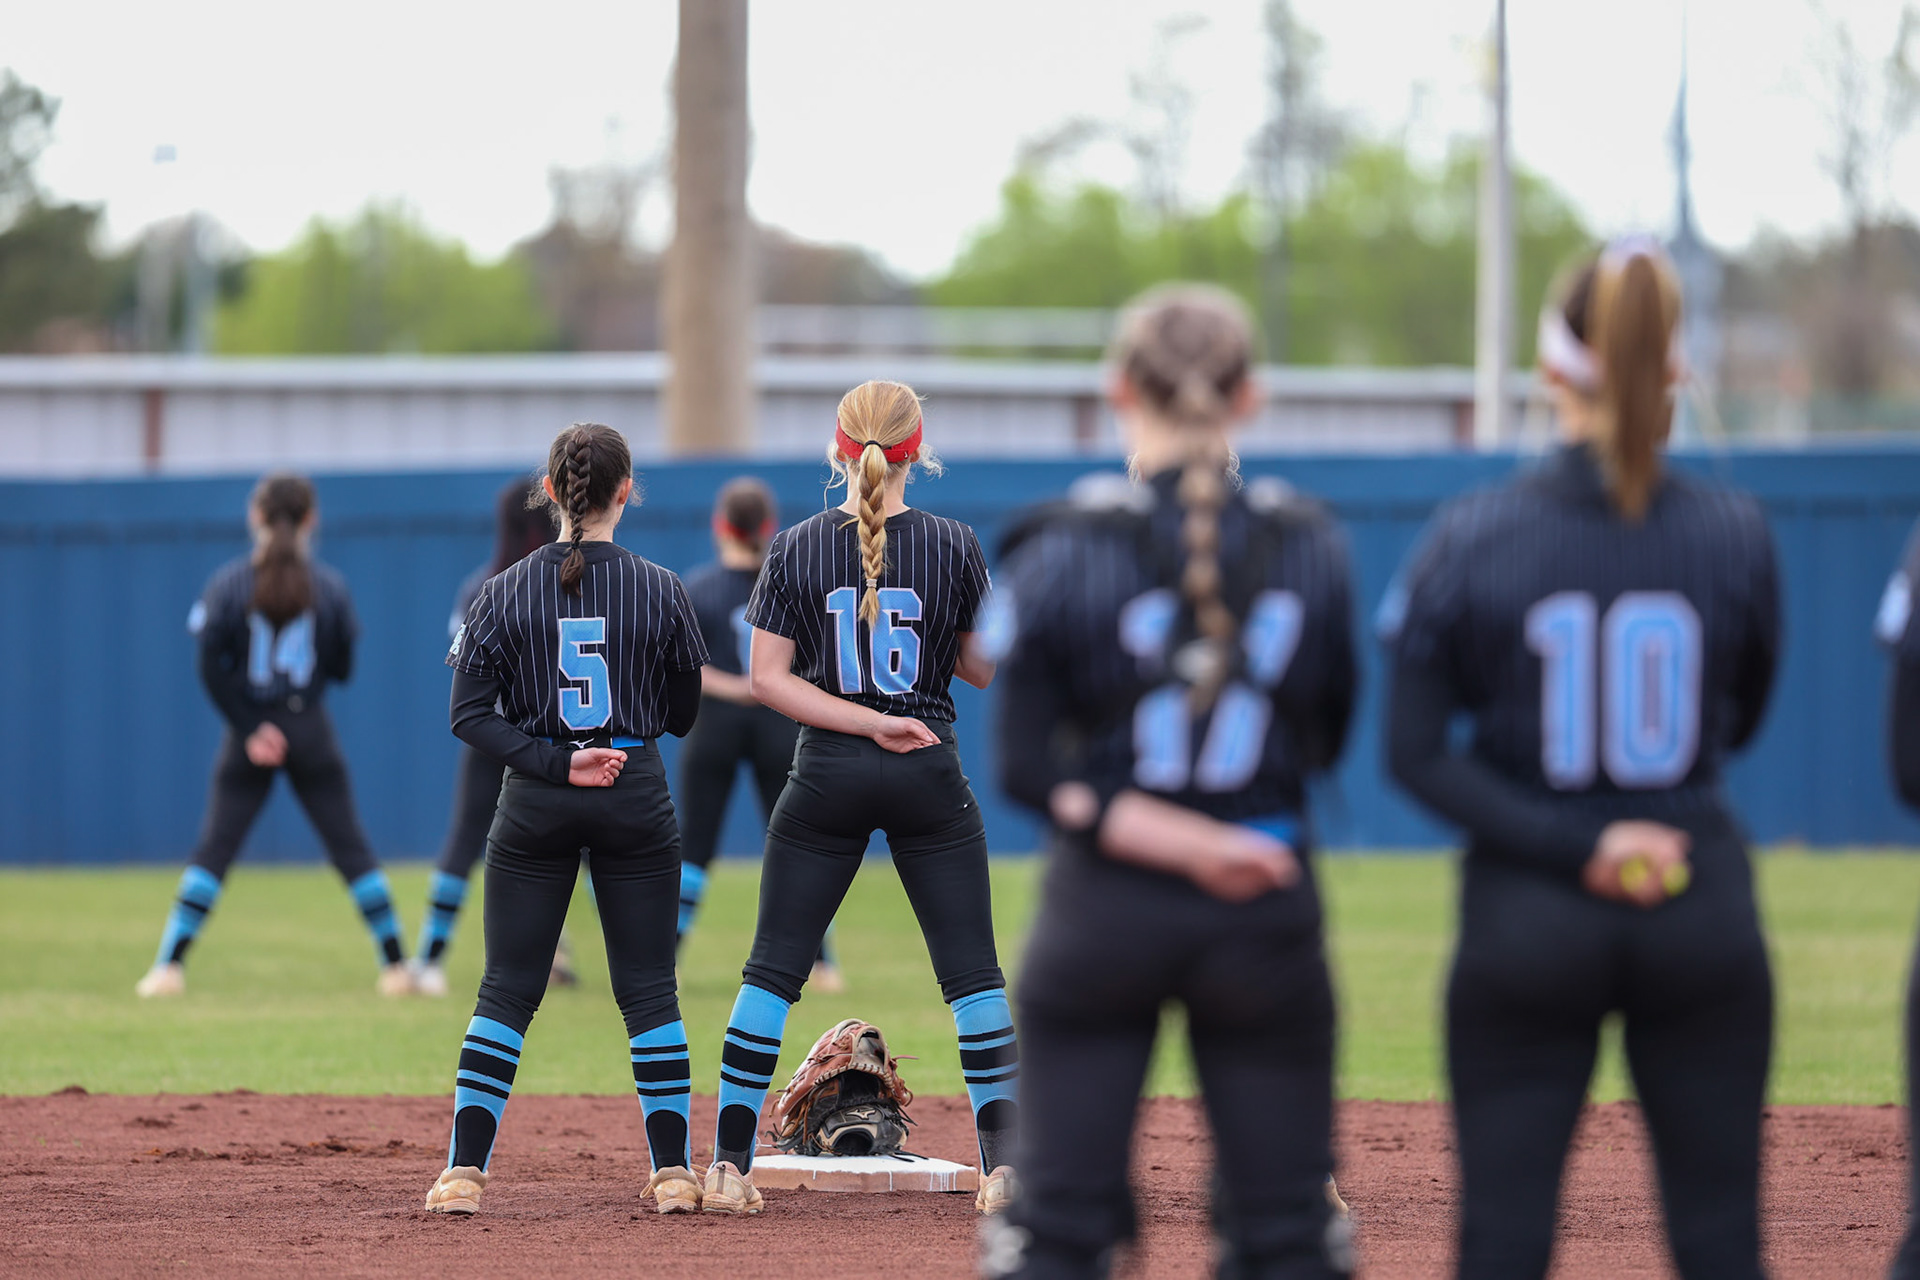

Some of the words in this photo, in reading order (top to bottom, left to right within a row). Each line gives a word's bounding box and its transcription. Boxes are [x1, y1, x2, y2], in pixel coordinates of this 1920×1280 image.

[247, 611, 317, 689] 14
[558, 617, 612, 730] 5
[826, 586, 922, 695] 16
[1526, 591, 1702, 788] 10
